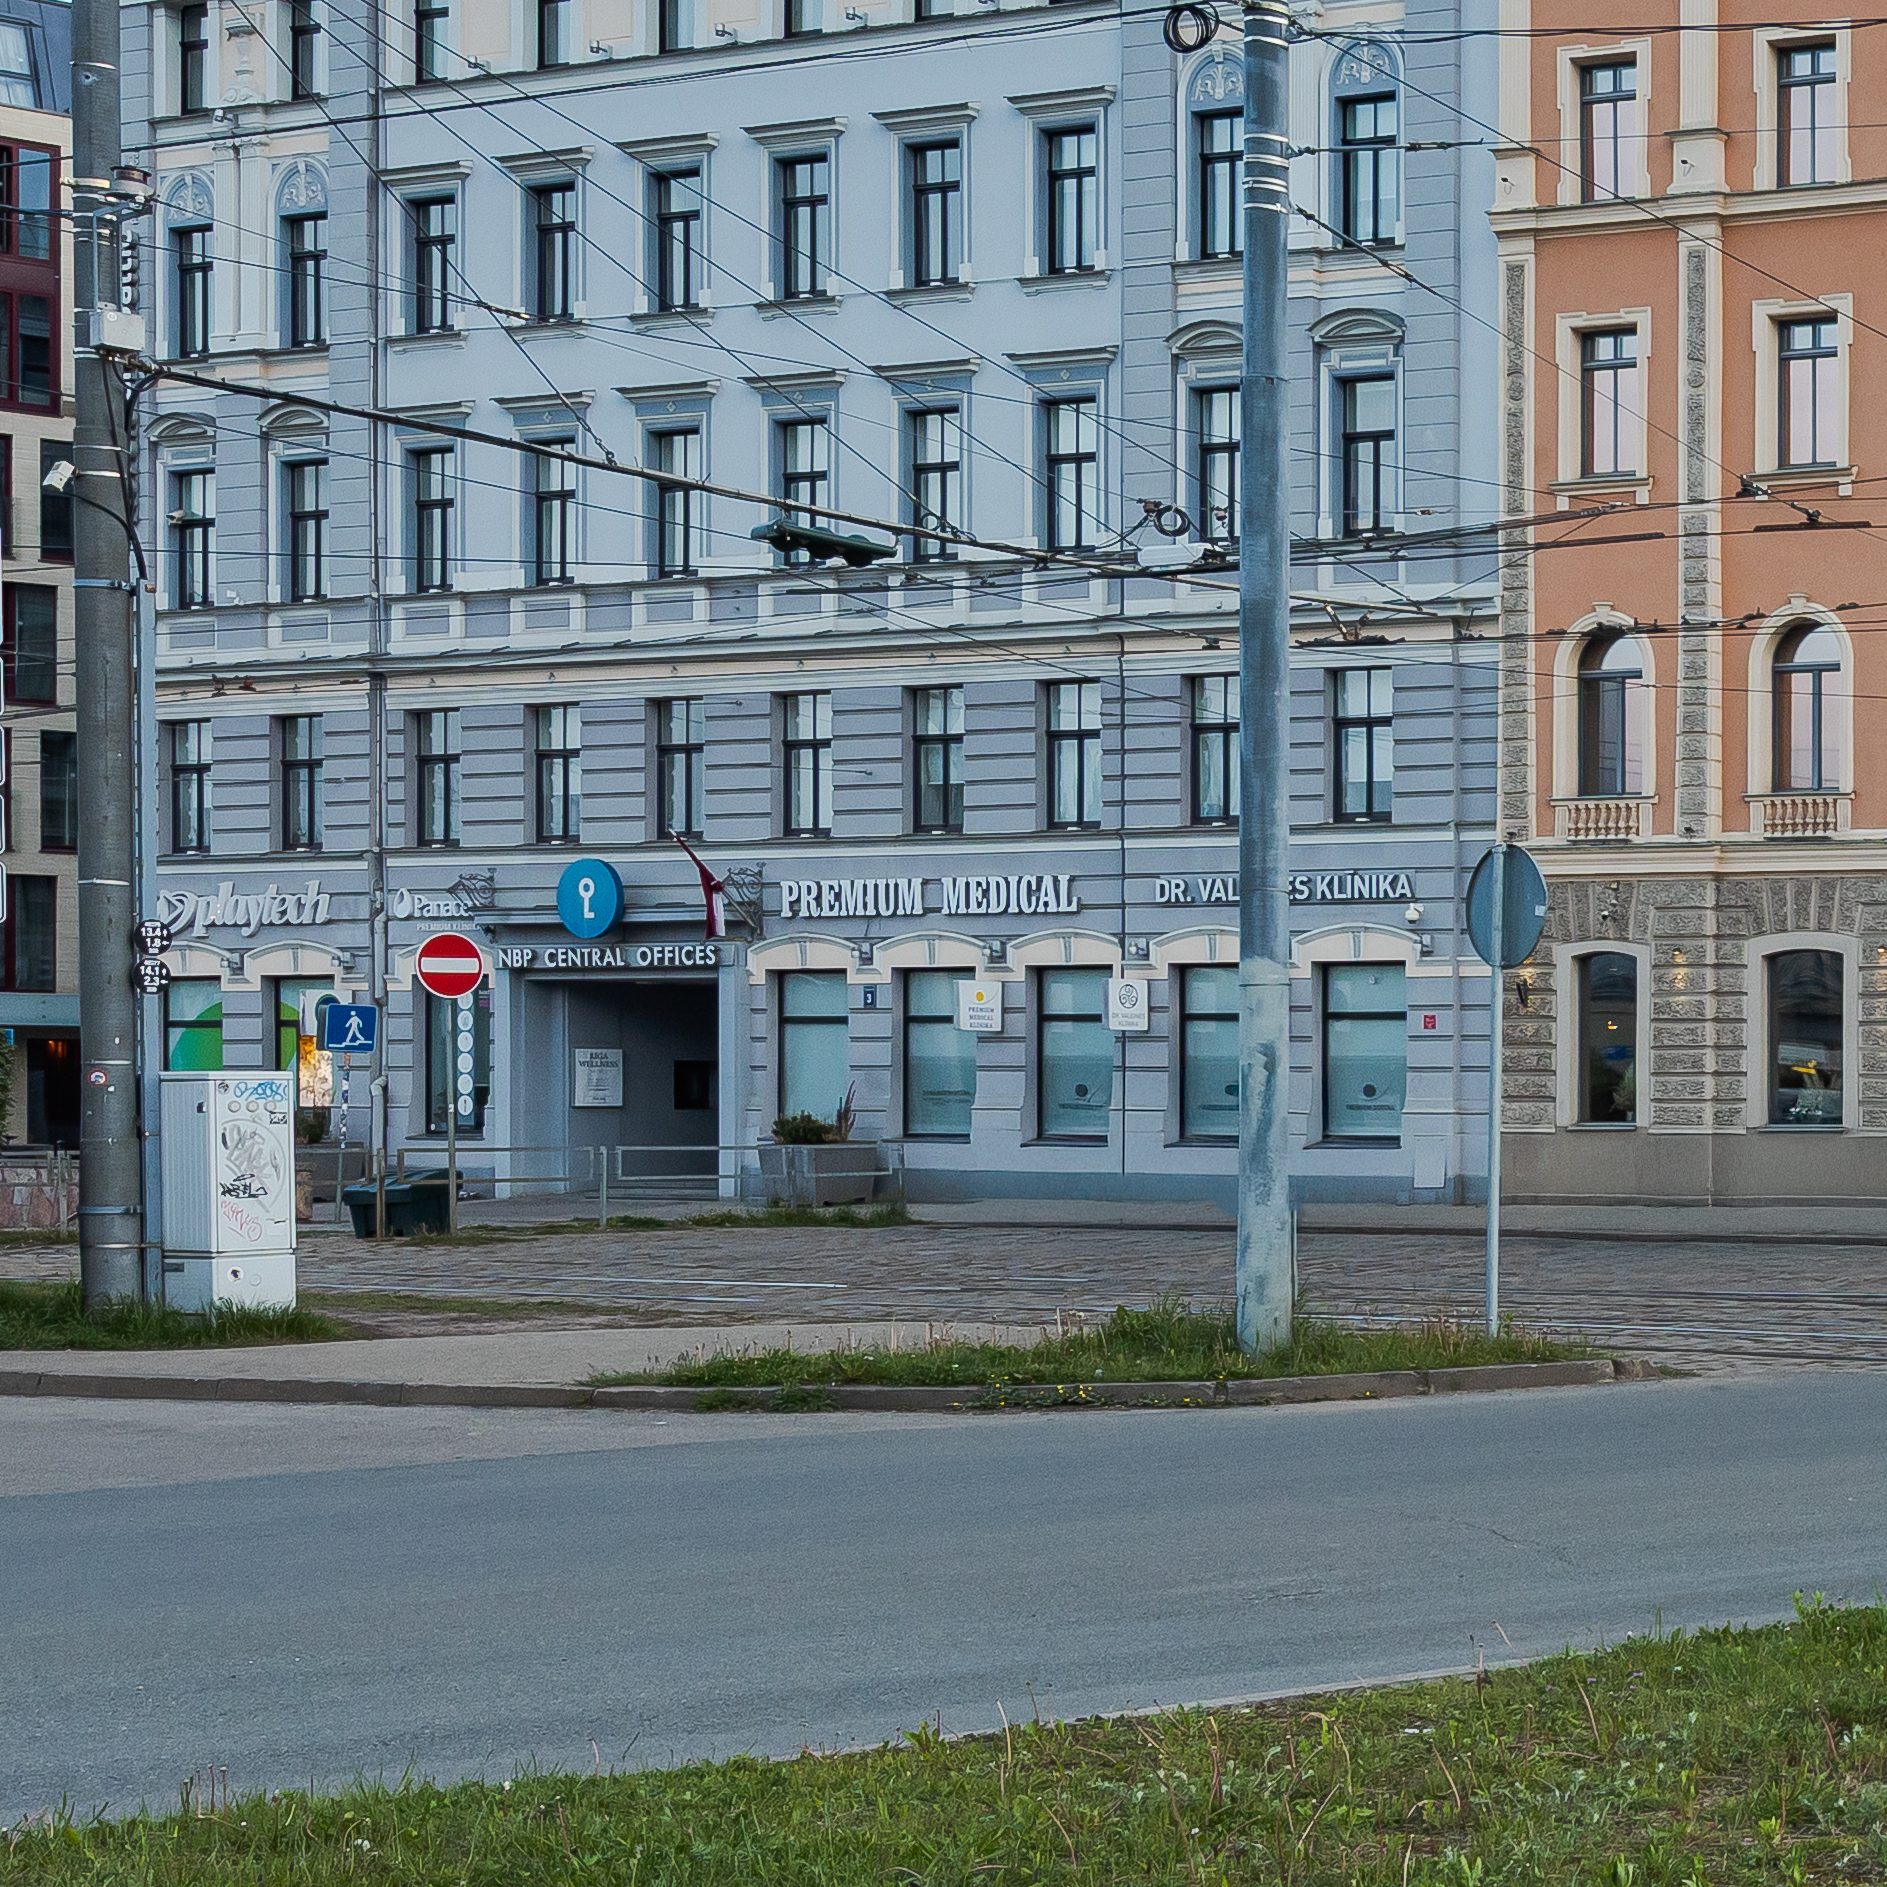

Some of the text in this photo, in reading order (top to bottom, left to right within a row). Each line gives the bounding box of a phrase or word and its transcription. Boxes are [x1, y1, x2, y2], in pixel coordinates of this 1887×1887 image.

[1155, 878, 1192, 903] DR.
[1316, 870, 1412, 900] KLĪNIKA
[781, 874, 1080, 918] PREMIUM MEDICAL
[191, 880, 330, 938] playtech
[141, 927, 162, 938] 13.4
[145, 938, 162, 948] 1.8
[498, 945, 717, 969] NBP CENTRAL OFFICES
[140, 965, 160, 976] 14.1
[866, 993, 873, 1004] 3
